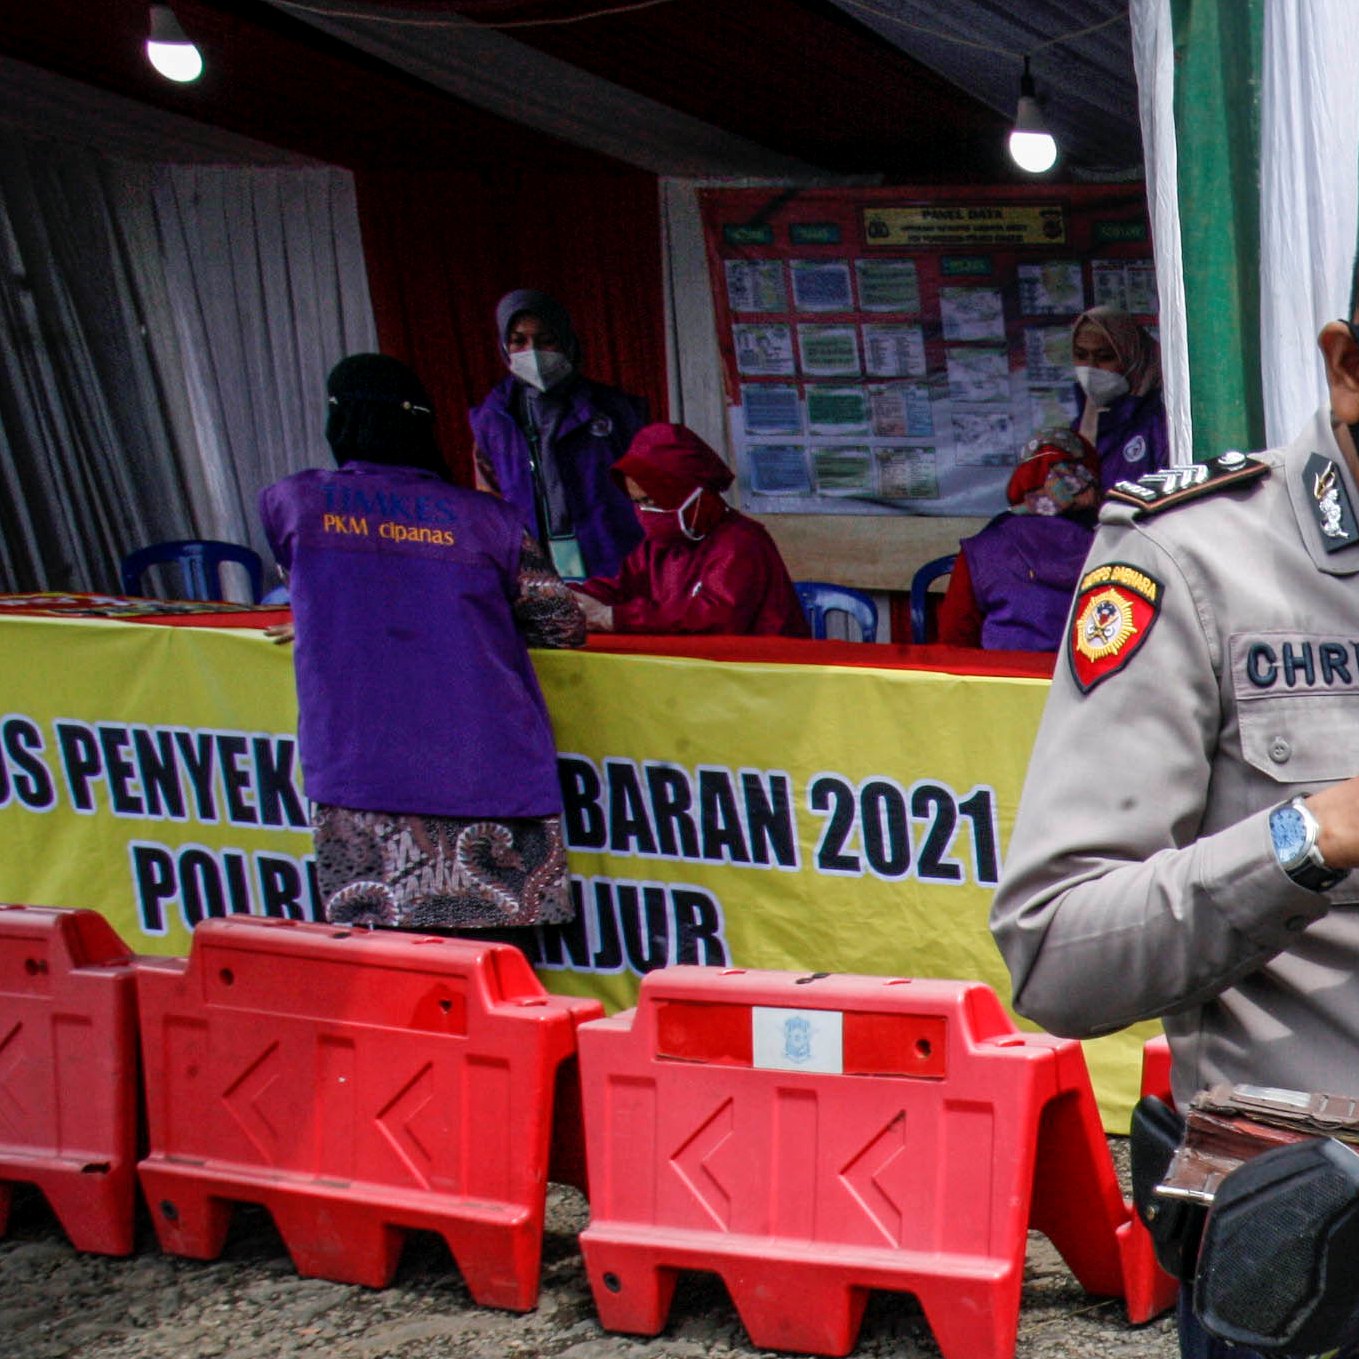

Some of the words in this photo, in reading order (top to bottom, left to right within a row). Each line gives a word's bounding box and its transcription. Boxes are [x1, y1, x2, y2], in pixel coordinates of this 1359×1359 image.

[322, 513, 369, 537] PKM
[0, 714, 55, 812] S
[558, 752, 801, 872] BARAN
[808, 770, 999, 887] 2021
